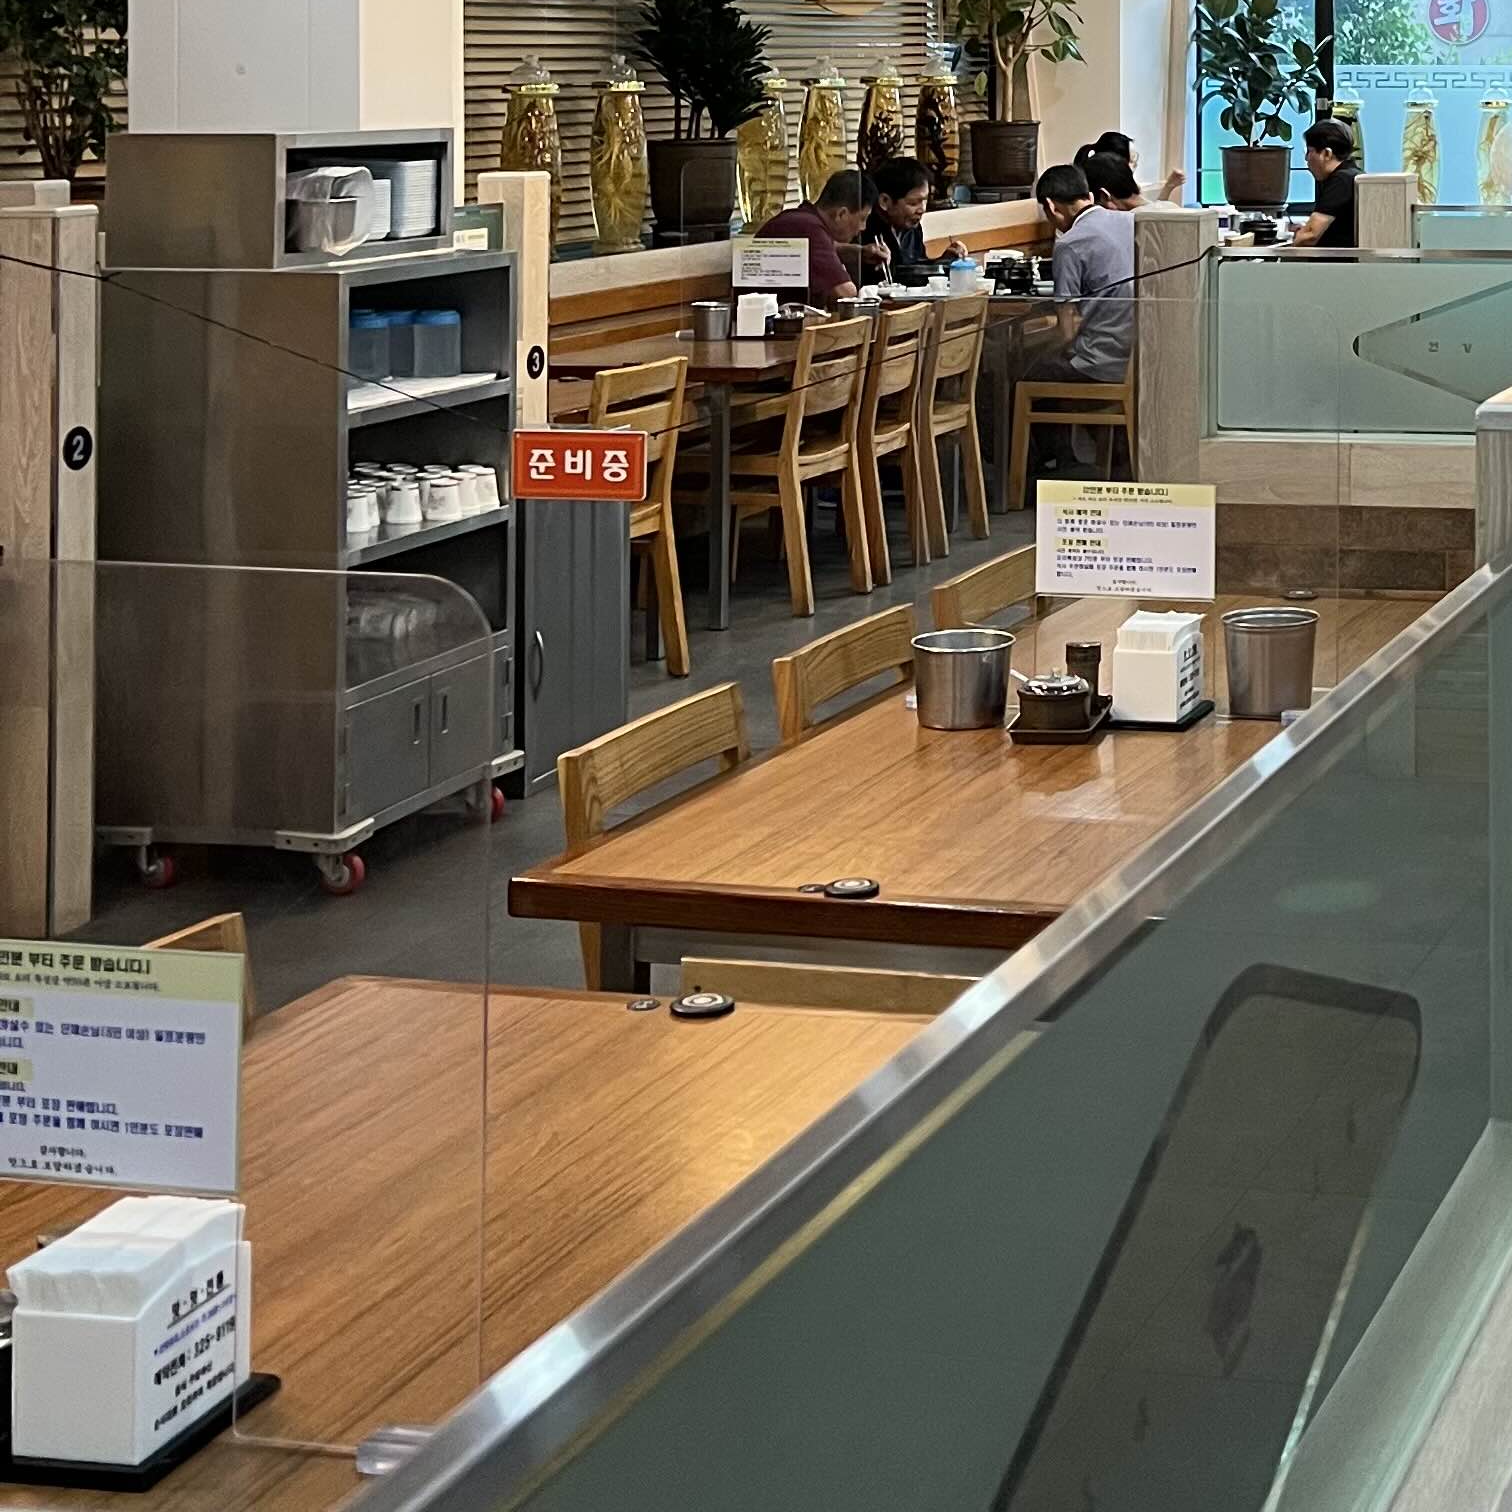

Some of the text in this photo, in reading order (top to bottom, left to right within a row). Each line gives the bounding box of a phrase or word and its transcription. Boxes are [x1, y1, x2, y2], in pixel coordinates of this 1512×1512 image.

[532, 352, 540, 372] 3
[72, 435, 84, 461] 2
[529, 449, 629, 482] 준비중
[29, 952, 53, 968] 부터
[60, 954, 84, 970] 주문
